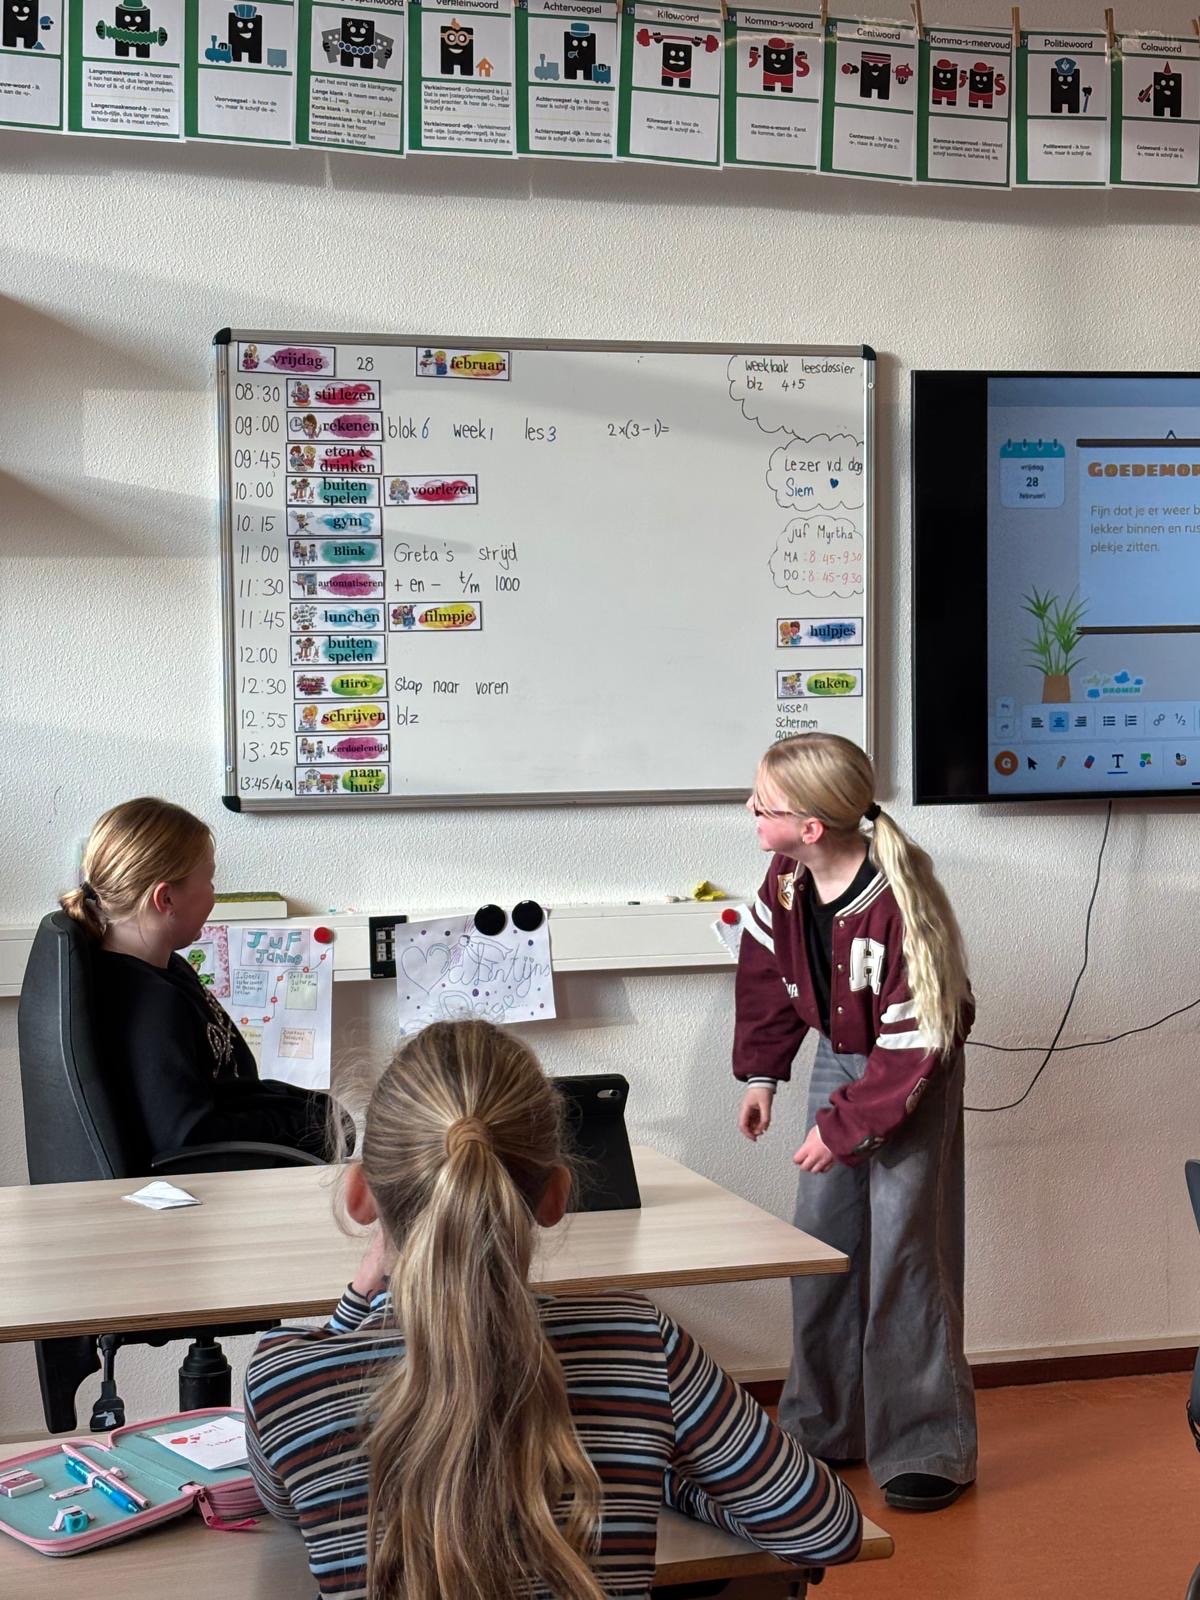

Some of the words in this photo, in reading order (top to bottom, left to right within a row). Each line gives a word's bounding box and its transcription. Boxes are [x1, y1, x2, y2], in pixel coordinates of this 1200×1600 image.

[543, 1, 601, 14] Achtervoegsel
[657, 10, 699, 22] Kilowoord
[745, 16, 813, 29] Komma-s-woord
[857, 28, 900, 40] Centwoord
[931, 34, 1010, 49] Komma-s-meervoud
[1044, 39, 1093, 49] Politiewoord
[1141, 43, 1182, 53] Colawoord
[272, 353, 323, 369] vrijdag
[357, 356, 374, 371] 28
[450, 356, 506, 371] februari
[801, 358, 855, 374] leesdossier
[235, 383, 280, 402] 08:30
[315, 386, 335, 400] stil
[340, 387, 376, 401] lezen
[235, 415, 280, 436] 09:00
[323, 420, 379, 432] rekenen
[388, 416, 417, 439] blok
[422, 417, 430, 439] 6
[525, 417, 544, 441] les
[547, 426, 556, 442] 3
[234, 449, 281, 469] 09:45
[325, 447, 354, 458] eten
[359, 446, 370, 458] &
[320, 459, 375, 473] drinken
[323, 477, 367, 491] buiten
[786, 477, 814, 496] Siem
[1026, 477, 1039, 487] 28
[235, 481, 274, 500] 10:00
[411, 484, 475, 496] voorlezen
[323, 493, 367, 506] spelen
[1091, 506, 1110, 519] Fijn
[1113, 505, 1131, 516] dat
[1135, 506, 1144, 518] je
[1148, 507, 1159, 516] er
[1163, 506, 1190, 516] weer
[236, 514, 275, 532] 10:15
[333, 518, 362, 529] gym
[1090, 524, 1123, 535] lekker
[1127, 523, 1164, 534] binnen
[1168, 525, 1181, 533] en
[817, 524, 853, 544] Myrtha
[240, 544, 278, 564] 11:00
[334, 546, 365, 556] Blink
[1090, 542, 1123, 554] plekje
[1126, 541, 1160, 552] zitten.
[393, 542, 454, 563] Greta's
[478, 542, 518, 570] strijd
[240, 578, 283, 598] 11:30
[318, 579, 383, 588] automatiseren
[410, 578, 424, 592] en
[496, 575, 520, 592] 1000
[241, 609, 286, 630] 11:45
[324, 610, 380, 623] lunchen
[424, 610, 473, 624] filmpje
[810, 625, 856, 639] hulpjes
[328, 636, 372, 649] buiten
[240, 646, 277, 664] 12:00
[328, 652, 373, 665] spelen
[241, 676, 287, 695] 12:30
[340, 679, 368, 689] Hiro
[433, 680, 460, 694] naar
[475, 681, 508, 695] voren
[815, 677, 849, 689] taken
[241, 709, 288, 729] 12:55
[322, 709, 386, 723] schrijven
[397, 705, 420, 725] blz
[243, 741, 291, 763] 13:25
[327, 744, 388, 754] Leerdoelentijd
[350, 768, 381, 778] naar
[350, 781, 380, 793] huis
